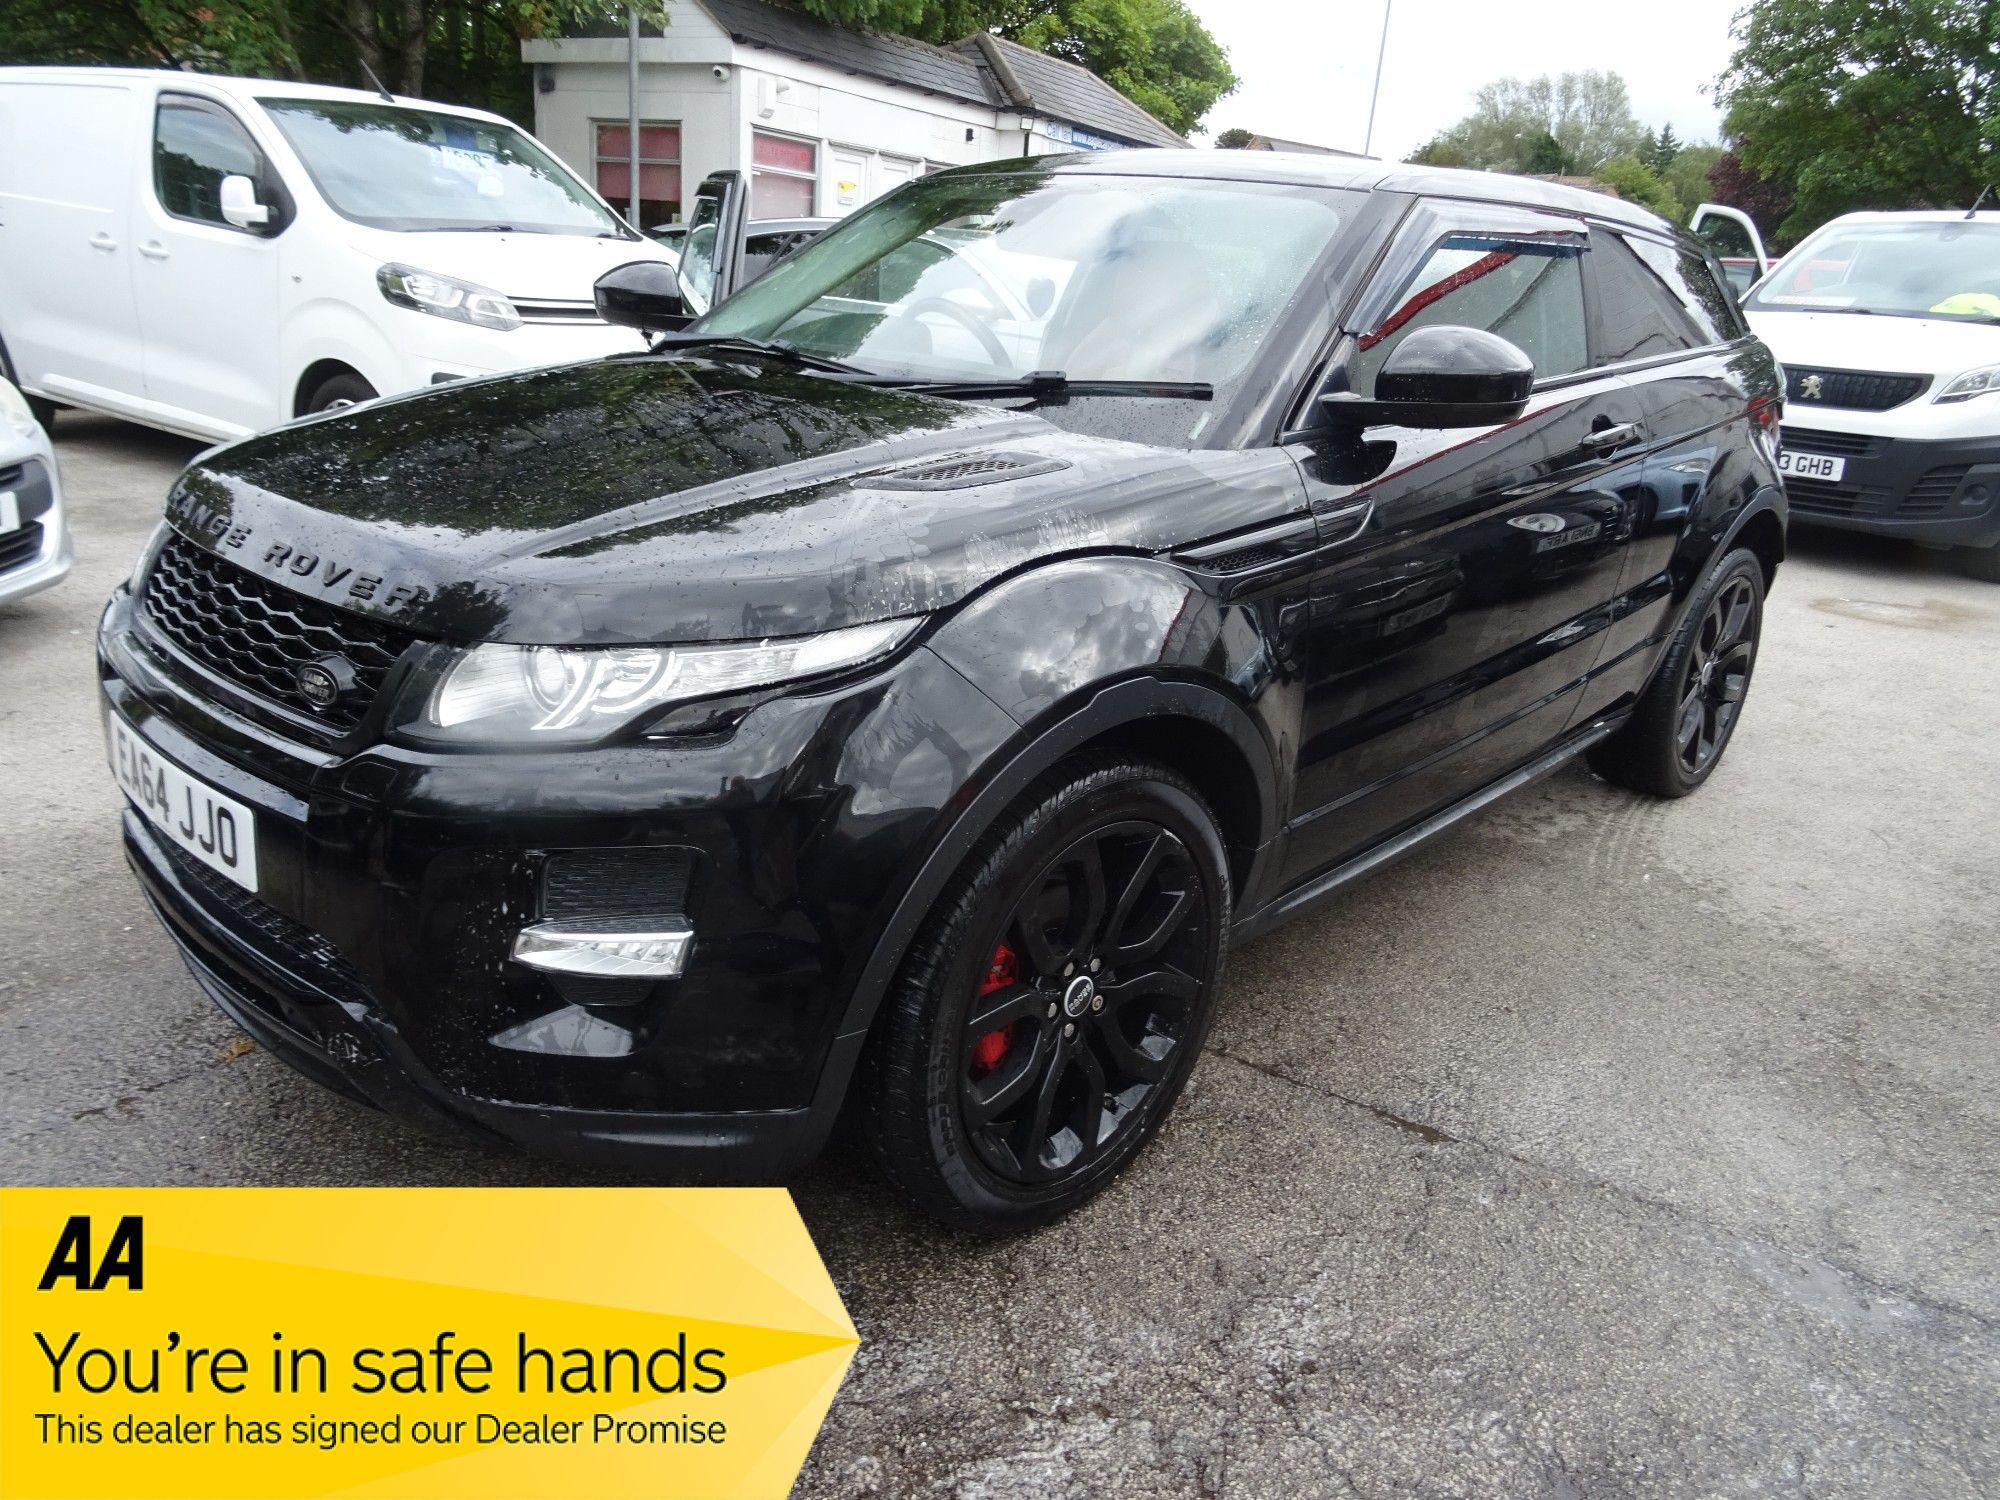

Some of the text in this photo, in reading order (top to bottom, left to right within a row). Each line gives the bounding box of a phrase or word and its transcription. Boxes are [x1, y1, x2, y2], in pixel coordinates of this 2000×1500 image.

[1796, 456, 1834, 476] GHB
[172, 490, 420, 607] RANGE ROVER
[117, 727, 170, 823] EA64
